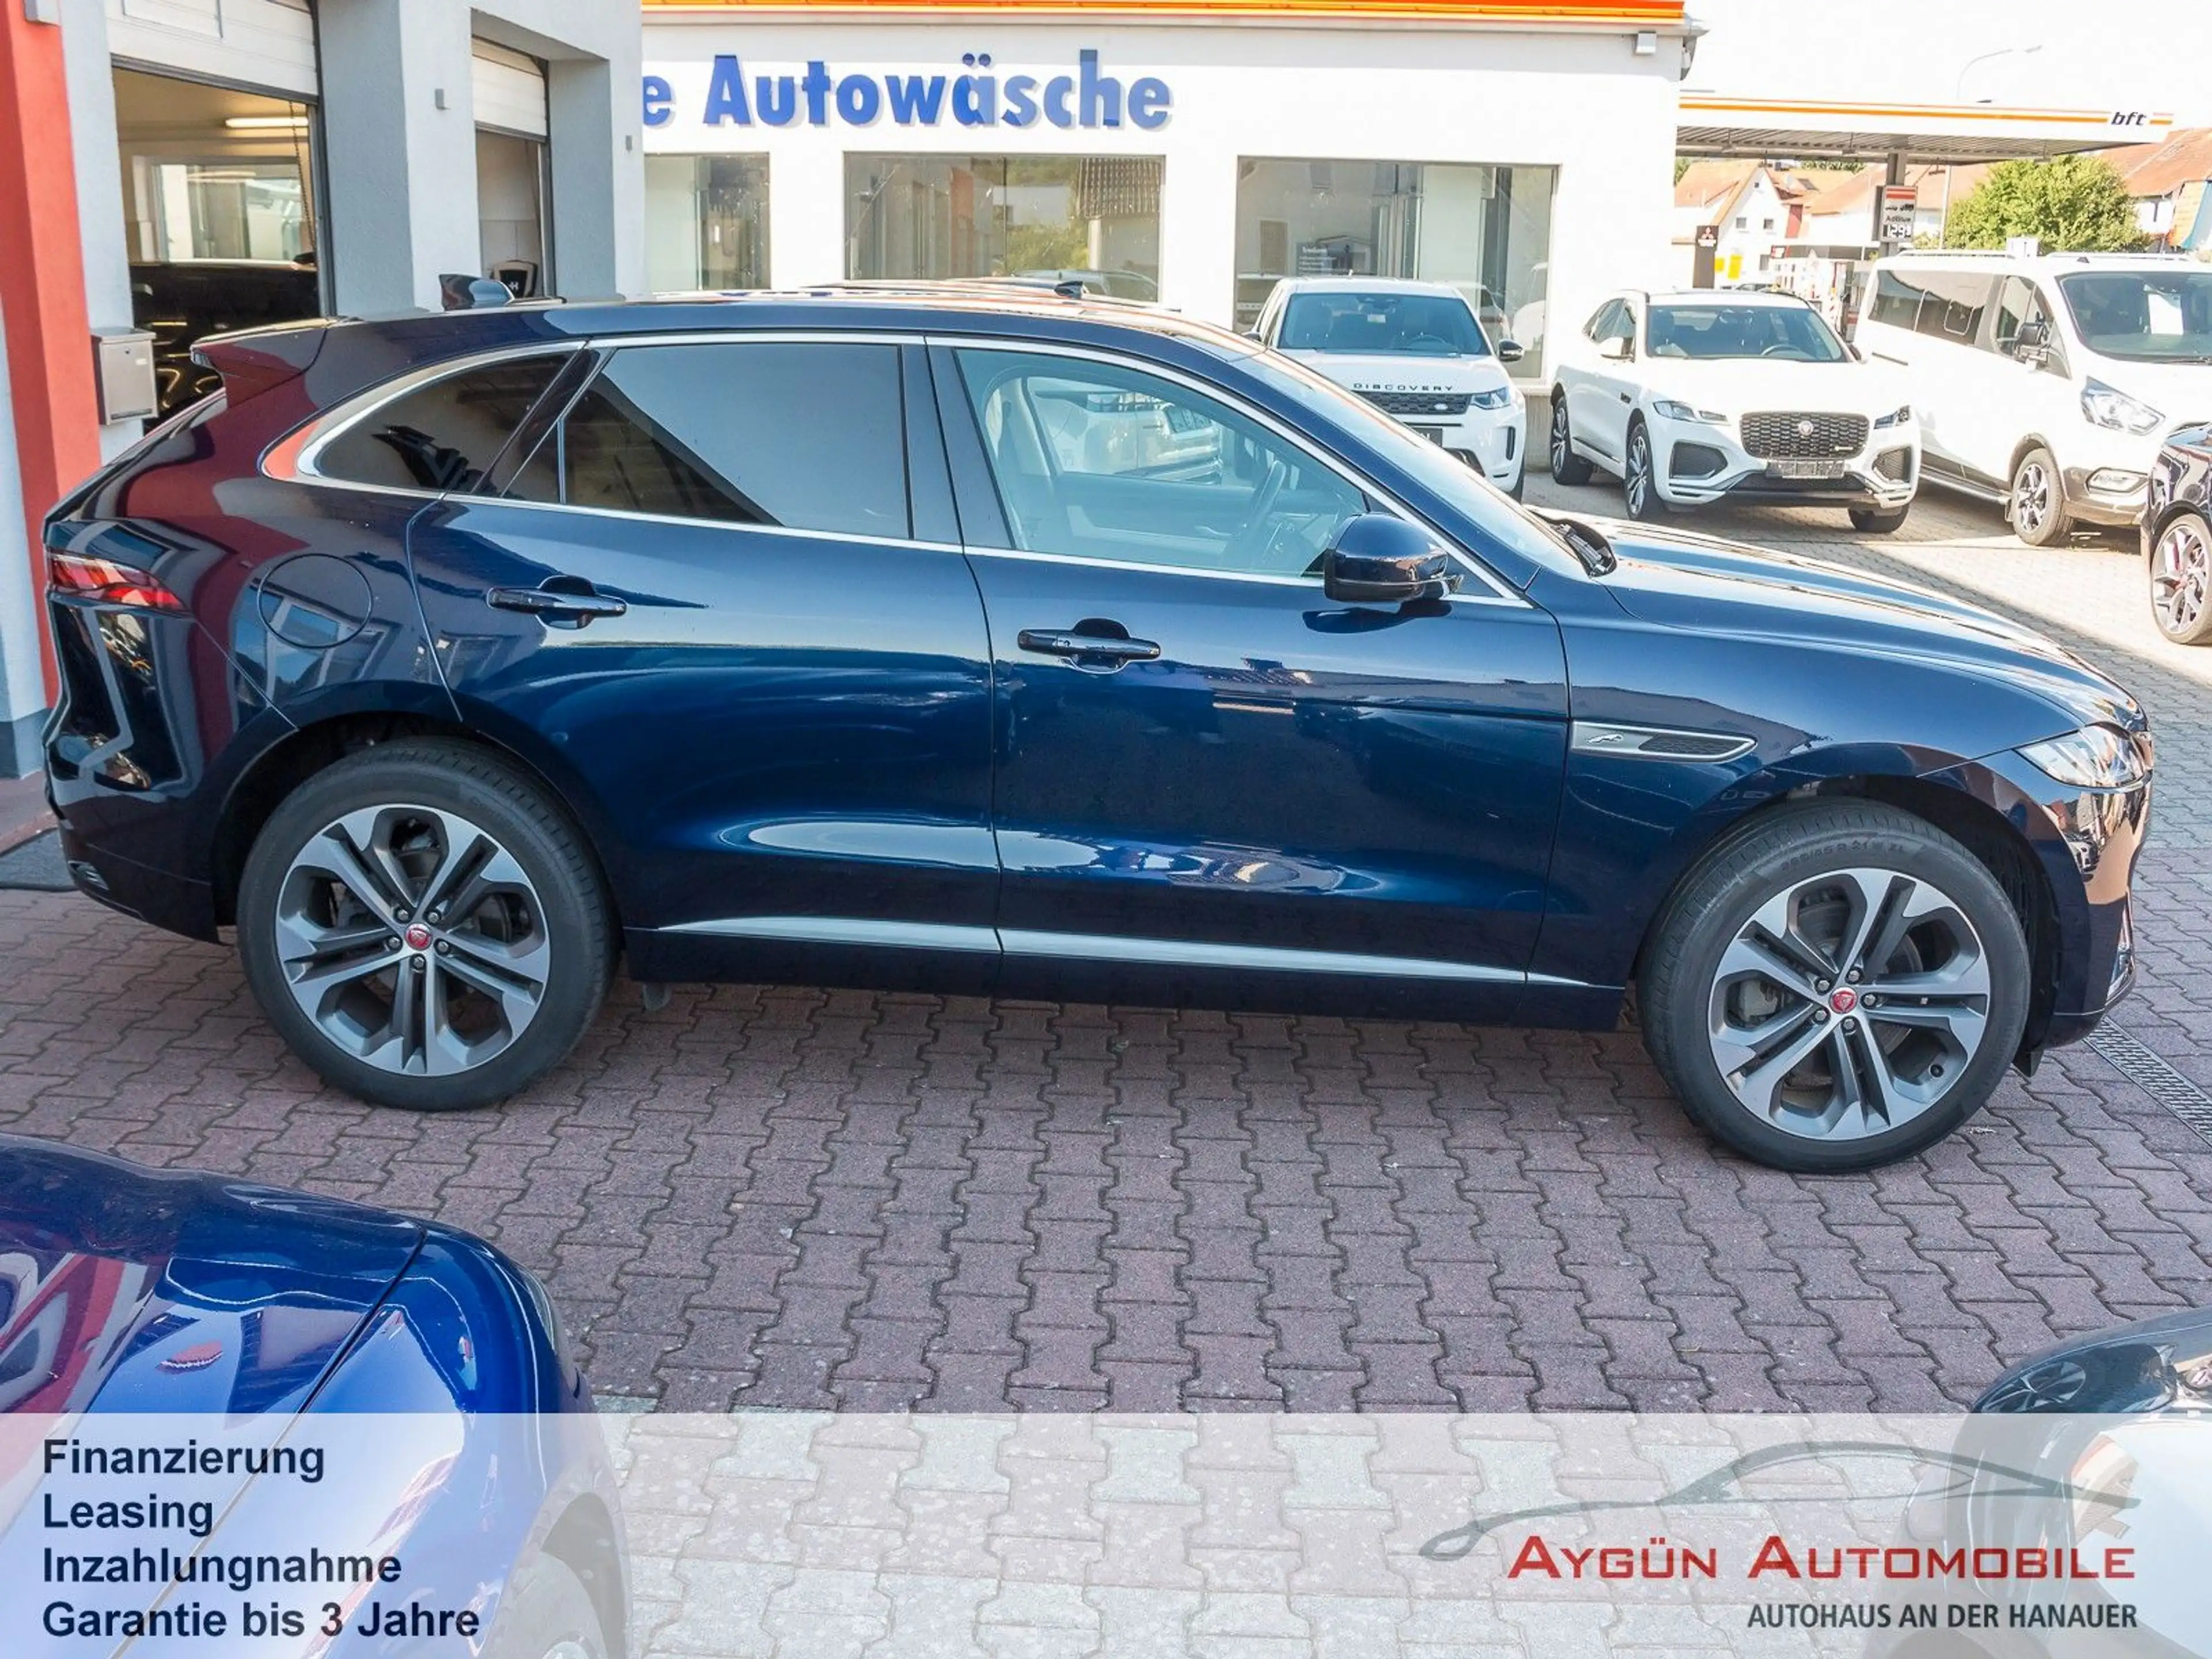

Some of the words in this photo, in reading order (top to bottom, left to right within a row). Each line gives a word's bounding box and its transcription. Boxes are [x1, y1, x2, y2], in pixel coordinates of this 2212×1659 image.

[703, 50, 1171, 128] Autowäsche
[2111, 111, 2147, 126] bft
[1353, 382, 1453, 391] DISCOVERY
